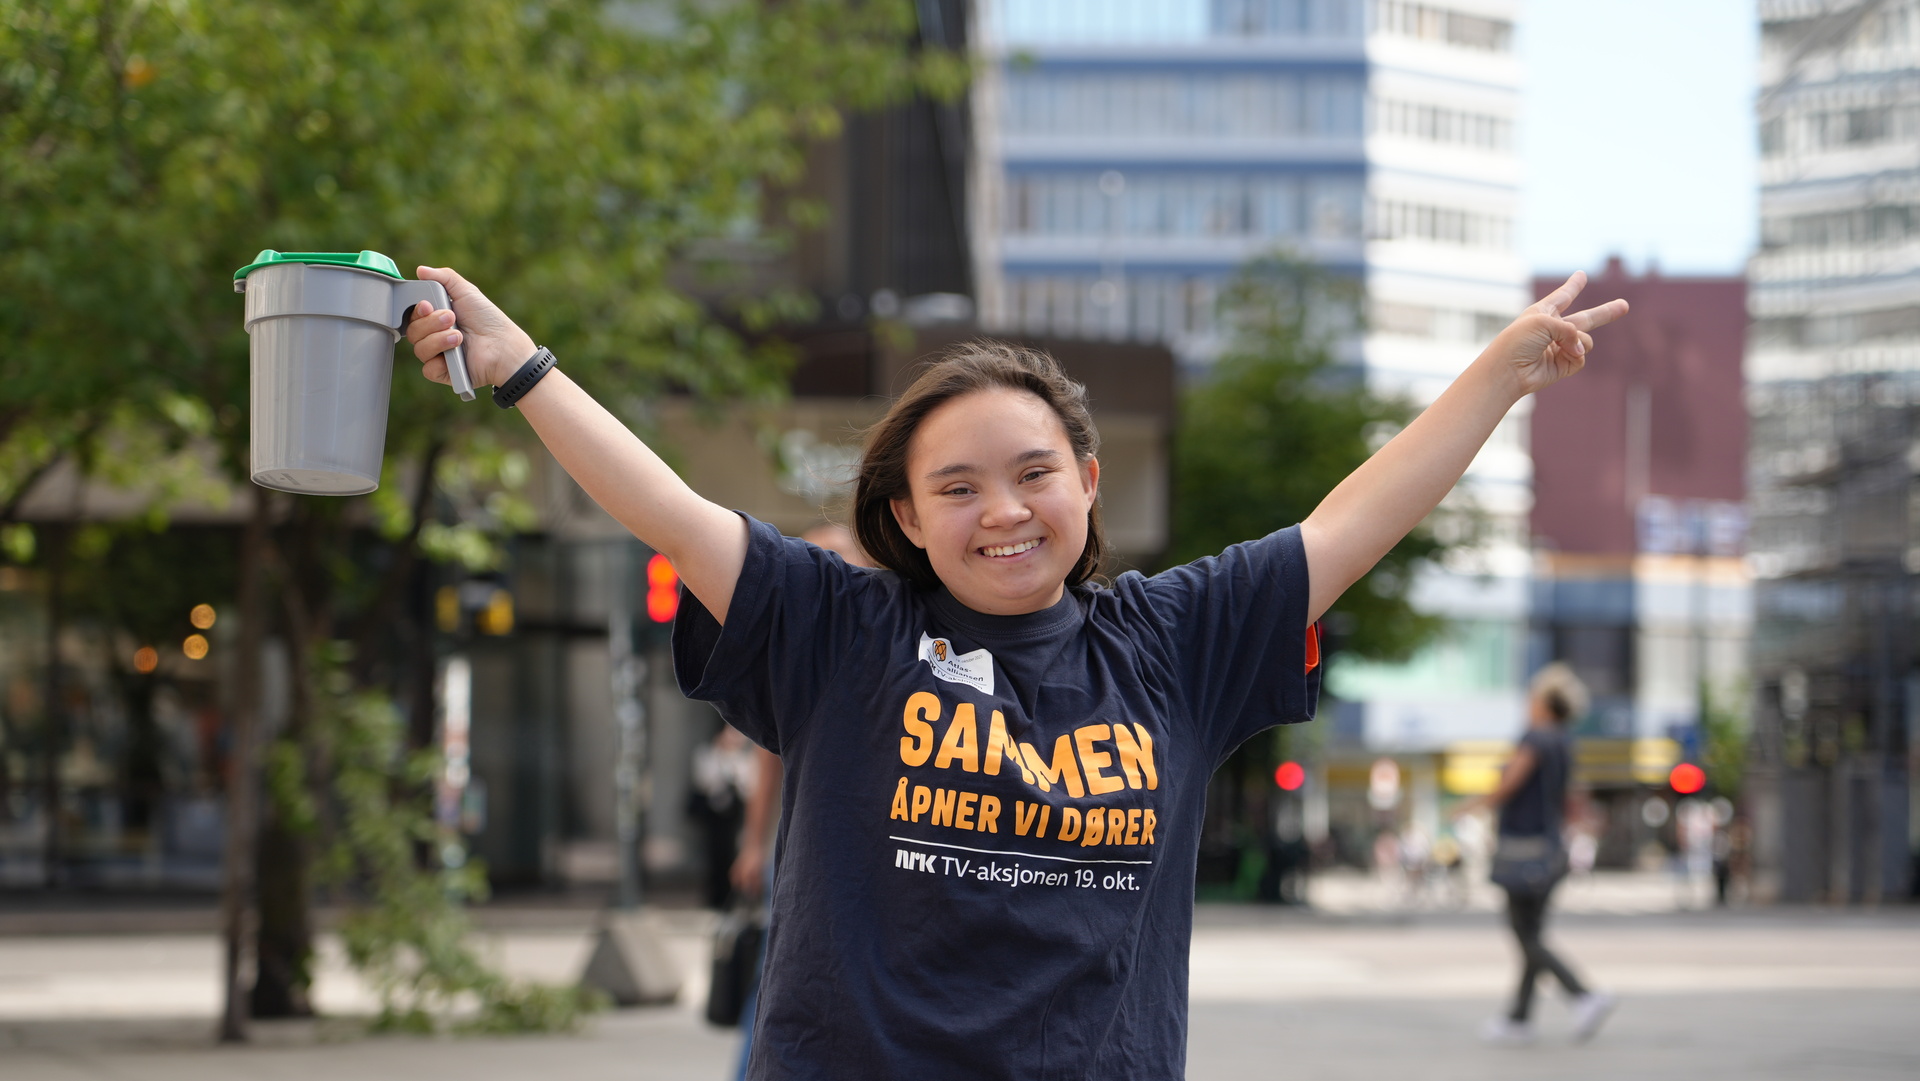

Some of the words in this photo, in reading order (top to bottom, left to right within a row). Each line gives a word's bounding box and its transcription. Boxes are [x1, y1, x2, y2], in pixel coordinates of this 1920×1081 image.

[946, 667, 984, 682] alliansen
[948, 660, 972, 673] Atlas-
[900, 691, 1158, 798] SAMMEN
[890, 776, 1002, 834] ÅPNER
[1014, 800, 1051, 838] VI
[1057, 807, 1157, 847] DØRER
[941, 855, 1069, 888] TV-aksjonen
[1074, 869, 1098, 889] 19.
[1102, 871, 1140, 891] okt.
